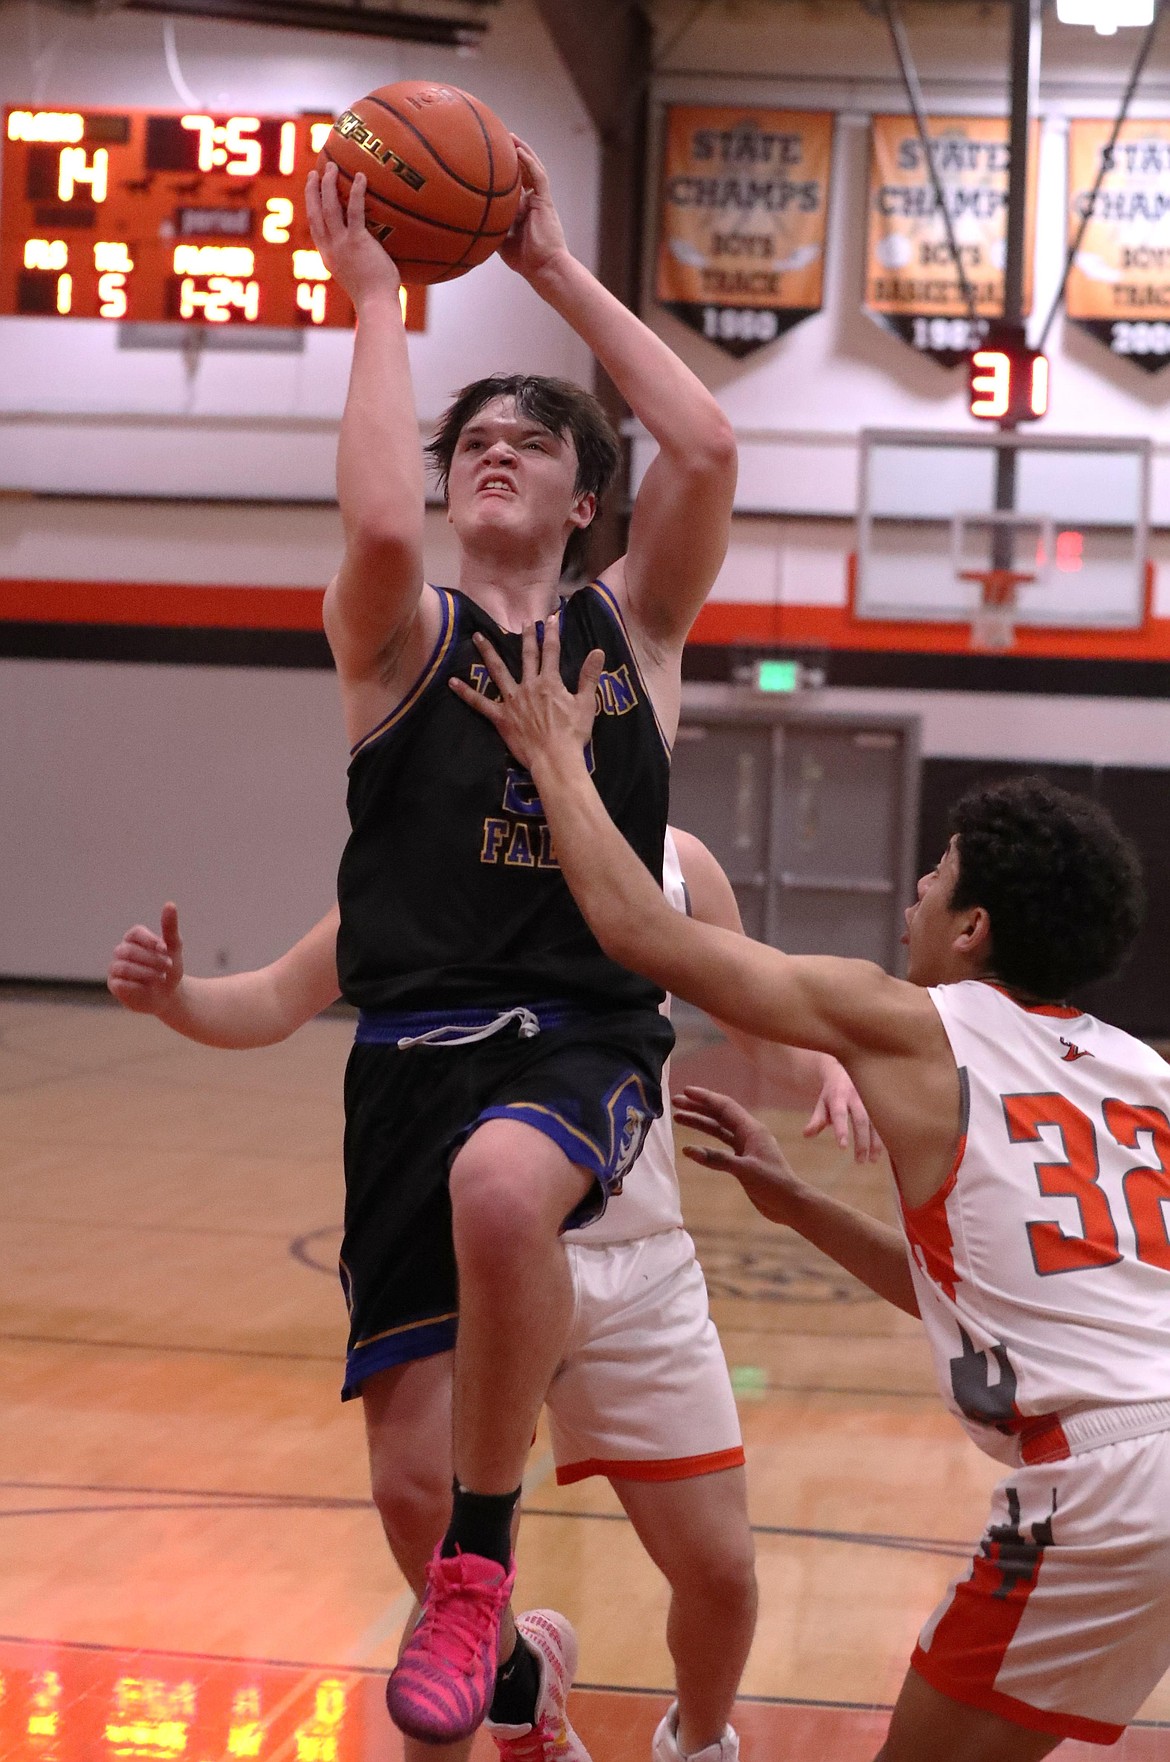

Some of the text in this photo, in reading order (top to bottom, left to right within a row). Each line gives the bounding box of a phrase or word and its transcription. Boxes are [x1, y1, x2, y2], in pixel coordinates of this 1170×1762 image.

[181, 115, 296, 175] 7:51
[692, 127, 802, 164] STATE
[1101, 143, 1170, 173] STA
[58, 147, 108, 203] 14
[668, 177, 819, 212] CHAMPS
[876, 185, 1008, 218] CHAMP
[1076, 191, 1170, 221] CHAM
[262, 197, 294, 243] 2
[711, 233, 774, 258] BOYS
[919, 240, 982, 266] BOYS
[1121, 247, 1170, 269] BOY
[57, 273, 72, 314] 1
[99, 272, 127, 318] 5
[701, 268, 780, 295] TRACK
[1112, 282, 1170, 308] TRAC
[296, 283, 326, 324] 4
[971, 351, 1049, 416] 31
[480, 817, 562, 869] FAL
[1000, 1091, 1170, 1277] 32
